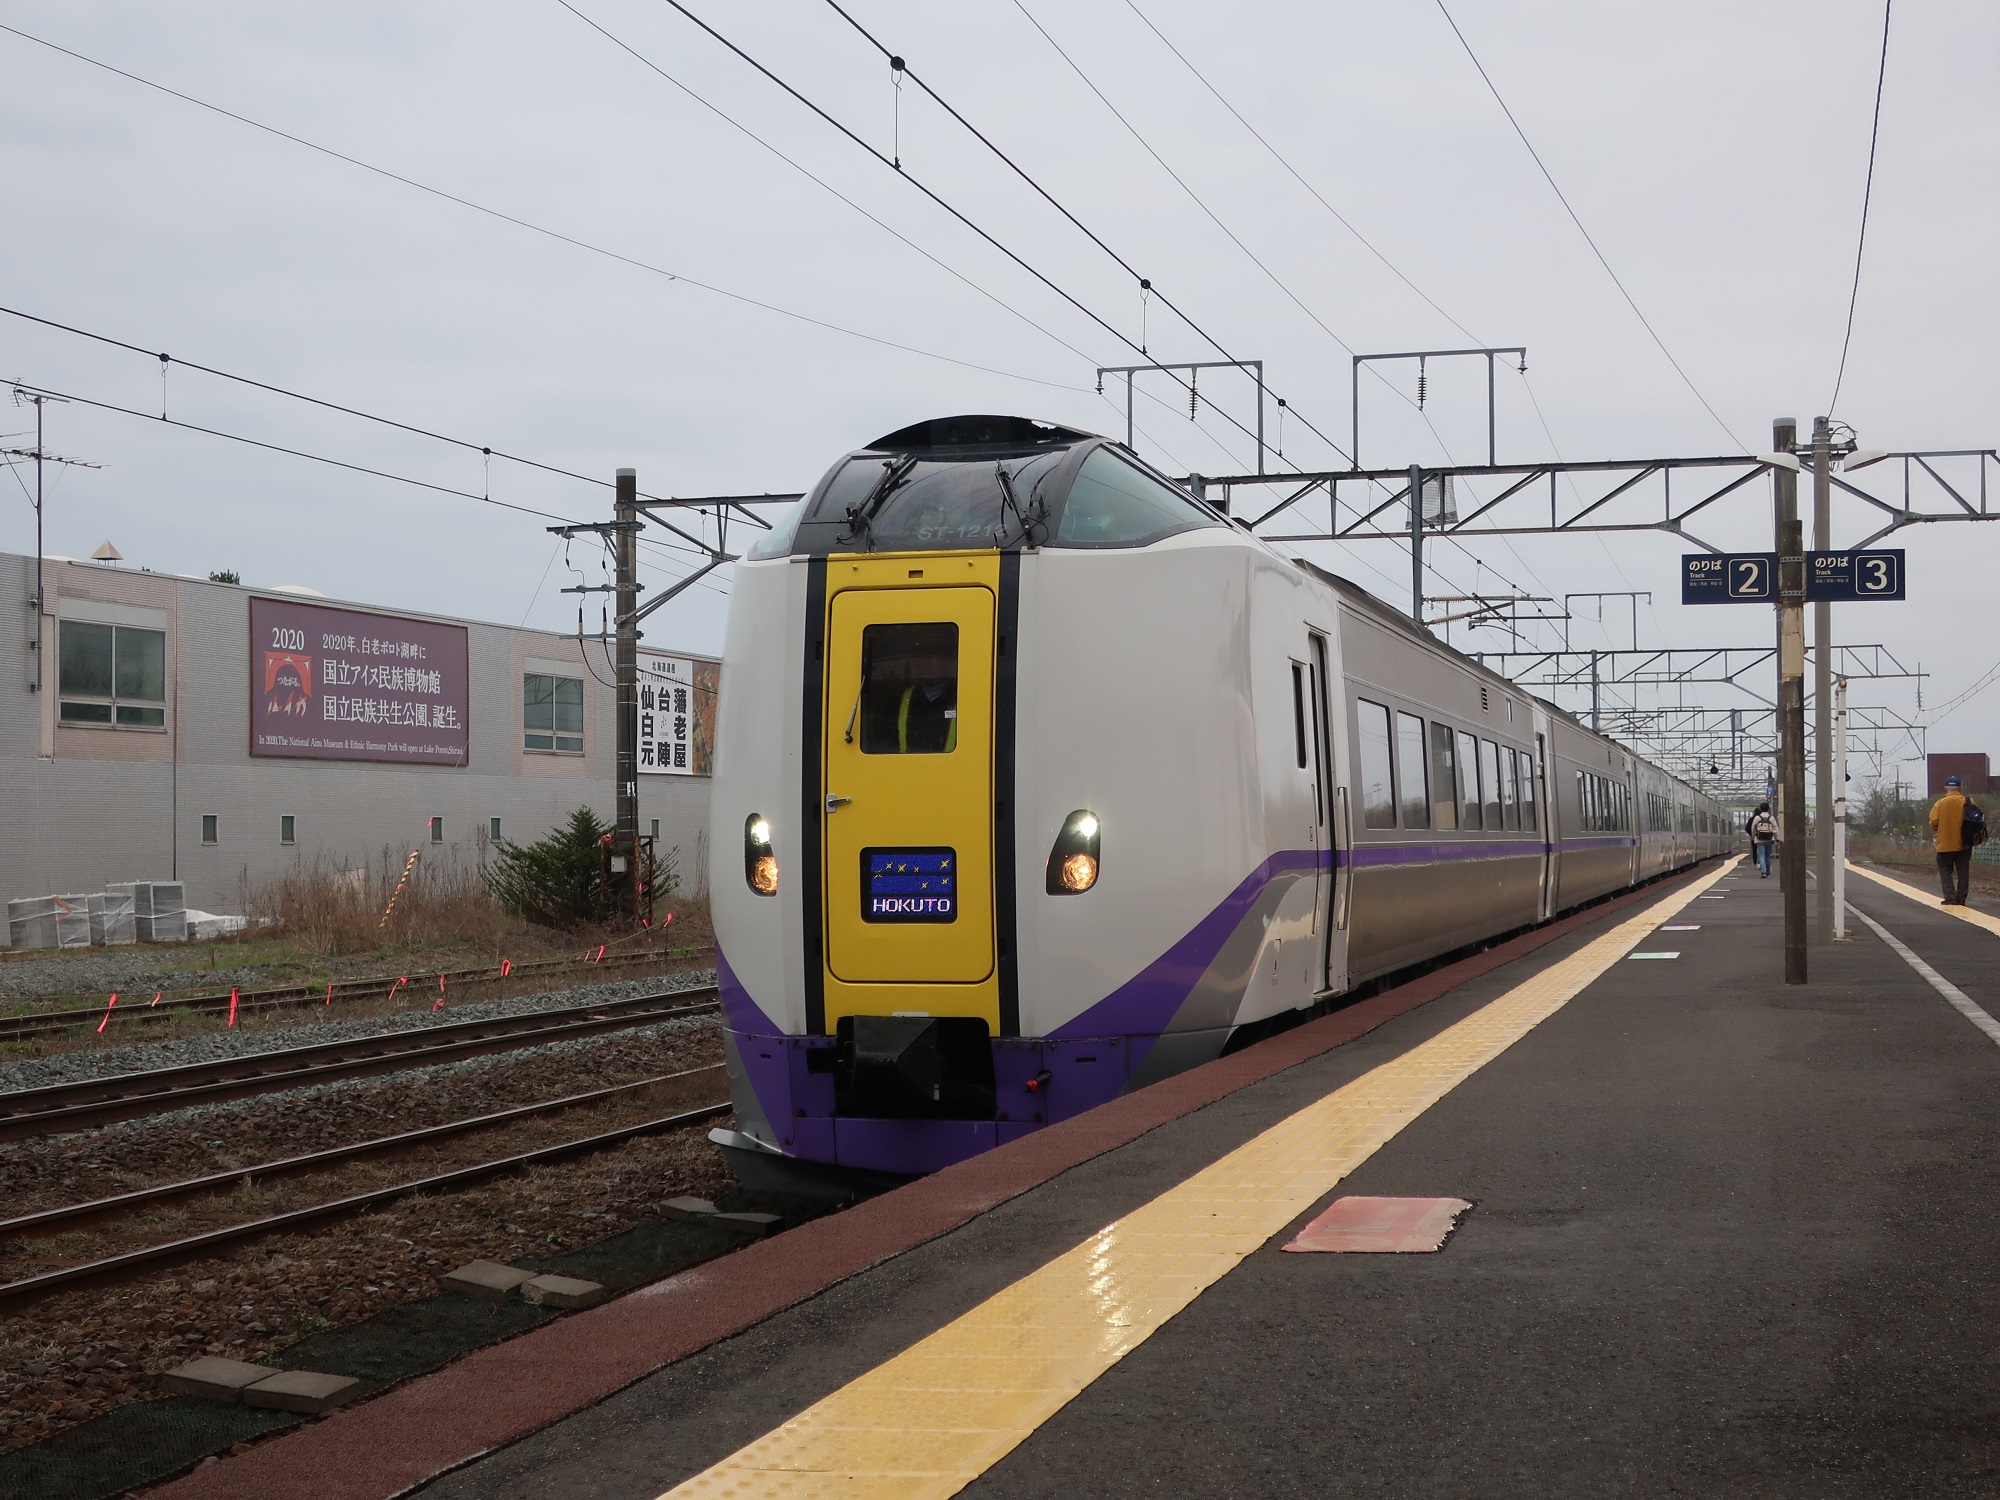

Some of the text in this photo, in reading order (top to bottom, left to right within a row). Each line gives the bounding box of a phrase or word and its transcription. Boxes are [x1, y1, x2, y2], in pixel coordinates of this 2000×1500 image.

[1689, 560, 1722, 571] のりば
[1815, 556, 1849, 568] のりば
[1738, 562, 1759, 593] 2
[1865, 559, 1888, 590] 3
[272, 627, 305, 650] 2020
[323, 658, 441, 695] 国立アイヌ民族博物館
[323, 695, 462, 730] 国立民族共生公園、誕生。
[289, 736, 310, 747] National
[323, 738, 344, 749] Museum
[344, 740, 349, 749] &
[387, 742, 398, 752] Park
[873, 898, 951, 912] HOKUTO
